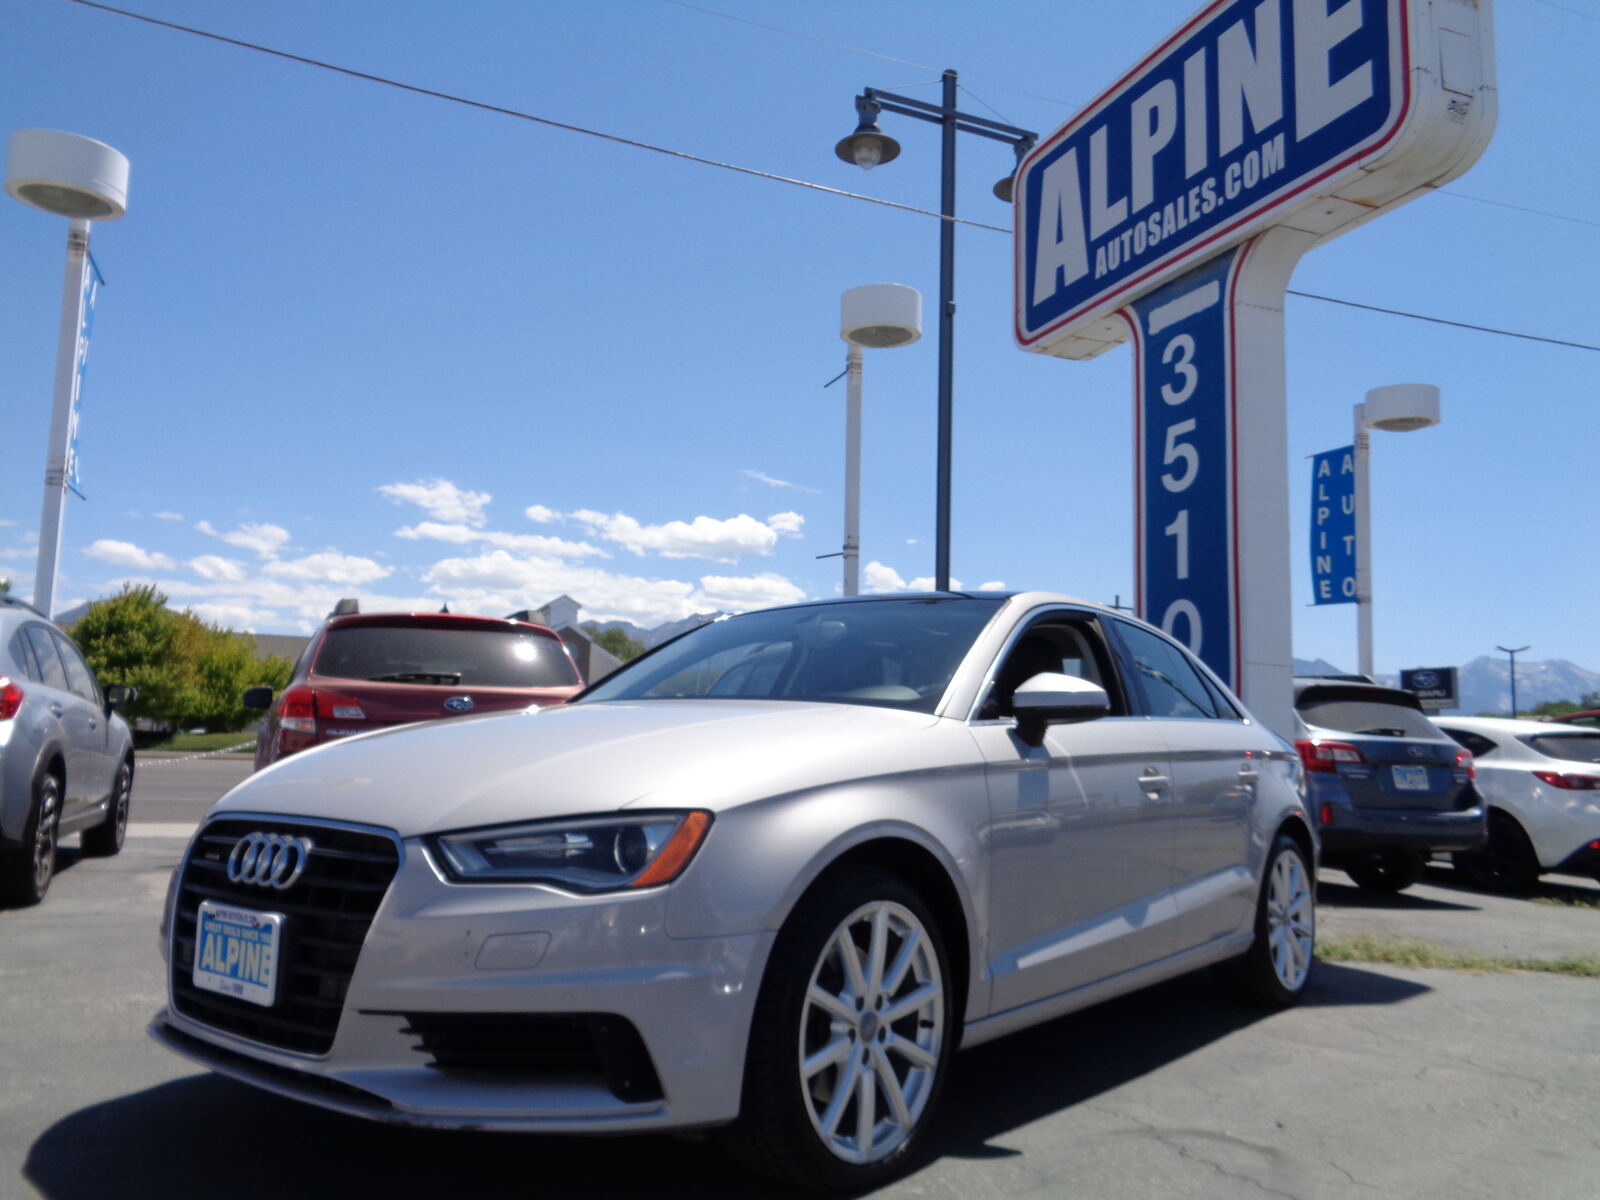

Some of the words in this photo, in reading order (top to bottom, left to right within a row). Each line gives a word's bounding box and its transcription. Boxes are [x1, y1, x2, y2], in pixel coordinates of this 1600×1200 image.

[1033, 0, 1373, 307] ALPINE
[1094, 132, 1285, 280] AUTOSALES.COM
[1317, 459, 1332, 599] ALPINE
[1341, 454, 1357, 597] AUTO
[1417, 689, 1447, 698] BARU
[201, 933, 272, 986] ALPINE
